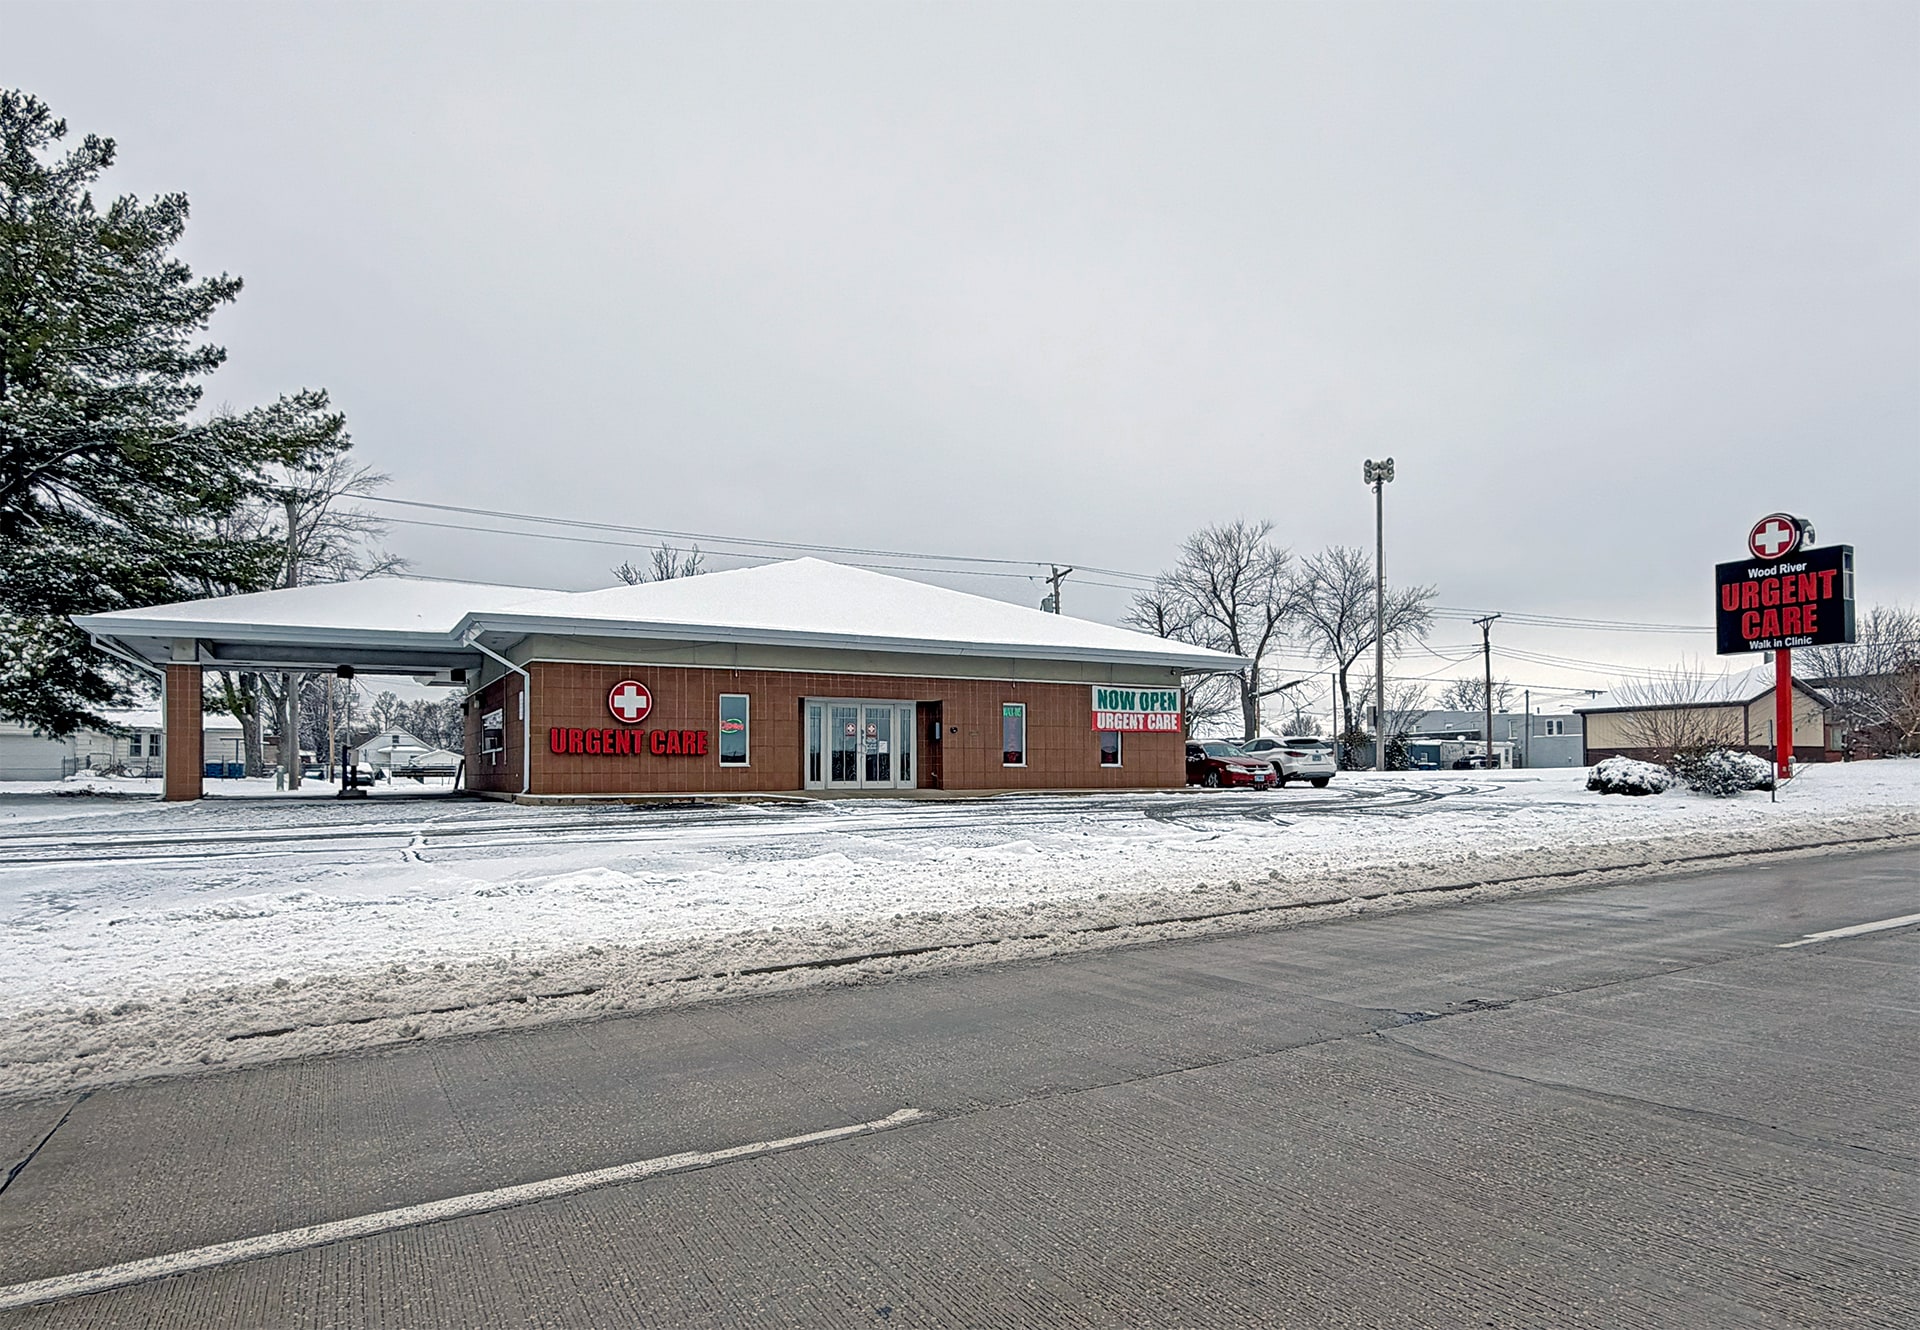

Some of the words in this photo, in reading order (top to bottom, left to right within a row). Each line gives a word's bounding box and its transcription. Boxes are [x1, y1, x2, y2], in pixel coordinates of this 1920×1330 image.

[1748, 565, 1777, 578] Wood
[1779, 562, 1807, 574] River
[1721, 569, 1837, 611] URGENT
[1741, 604, 1818, 639] CARE
[1749, 640, 1771, 650] Walk
[1774, 638, 1782, 647] in
[1785, 636, 1812, 647] Clinic
[1097, 689, 1137, 711] NOW
[1139, 690, 1177, 712] OPEN
[1097, 713, 1144, 729] URGENT
[1147, 714, 1178, 730] CARE
[550, 727, 644, 754] URGENT
[650, 729, 708, 755] CARE
